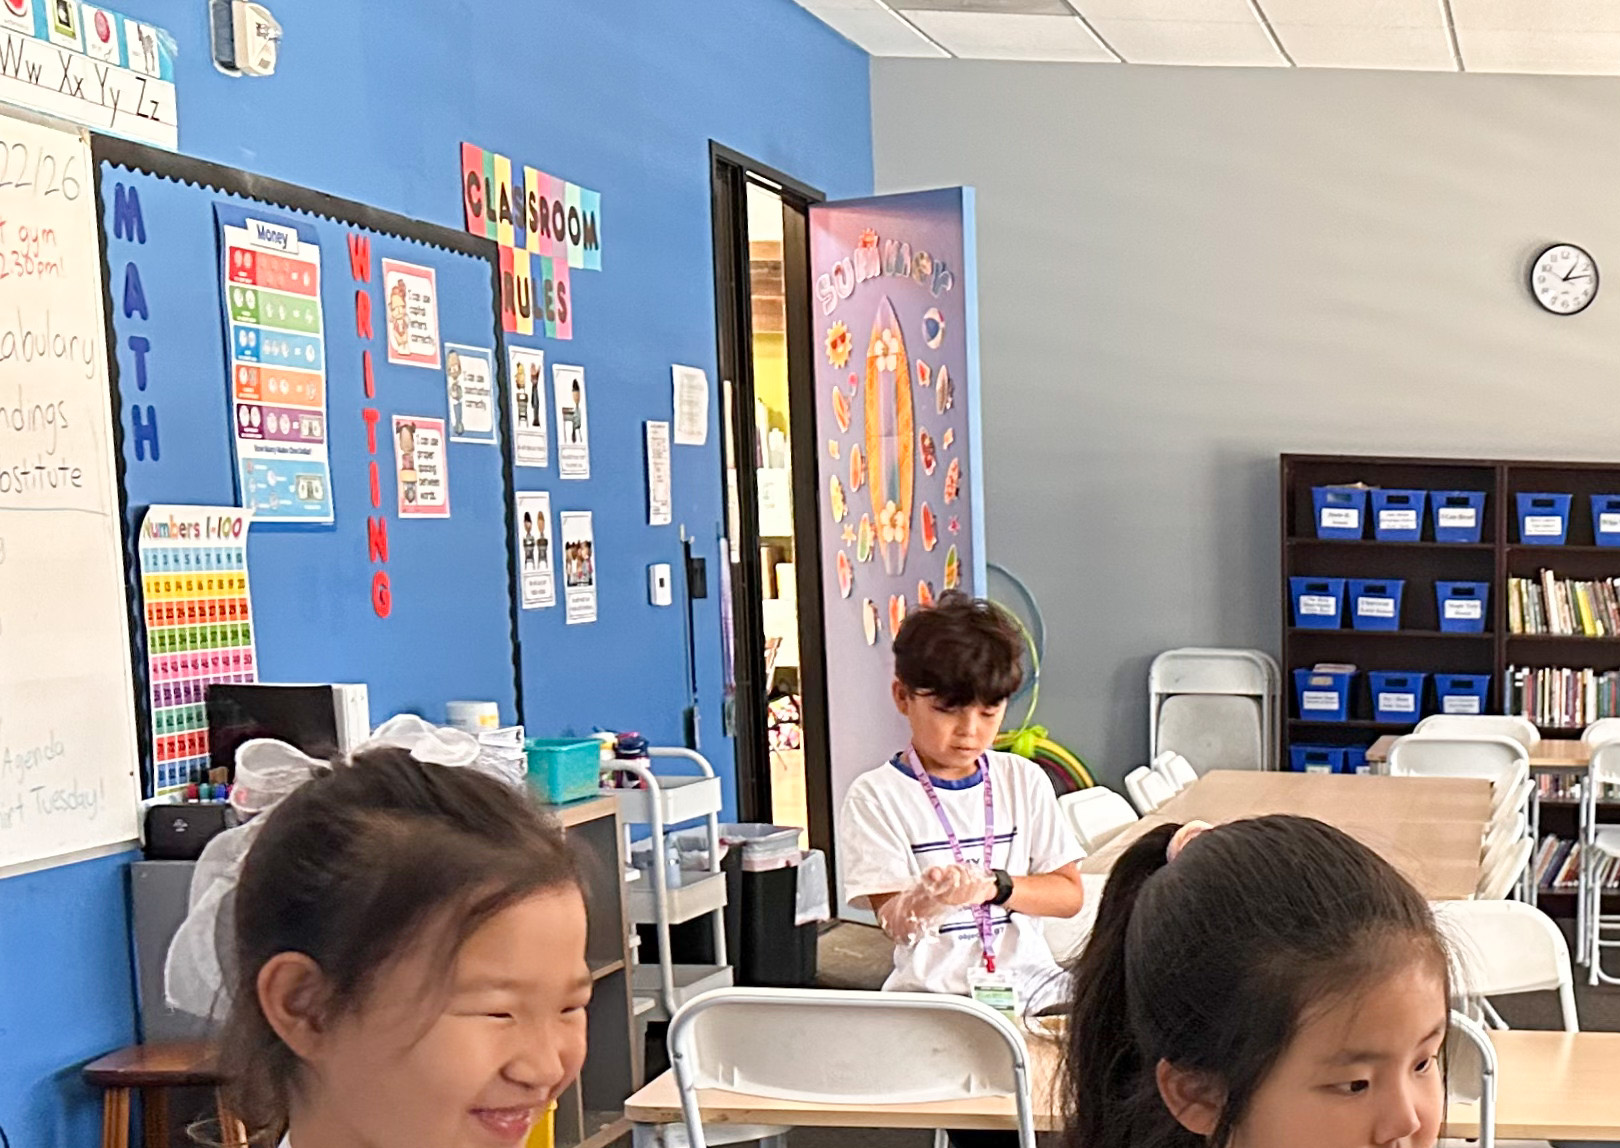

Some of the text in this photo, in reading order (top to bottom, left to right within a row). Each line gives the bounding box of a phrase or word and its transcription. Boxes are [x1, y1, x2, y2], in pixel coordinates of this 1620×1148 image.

[256, 223, 289, 250] Money
[467, 170, 599, 251] CLASSROOM
[113, 182, 160, 462] MATH
[503, 271, 569, 324] RULES
[0, 305, 95, 380] abulary
[347, 232, 391, 619] WRITING
[143, 514, 243, 540] Numbers 1-100
